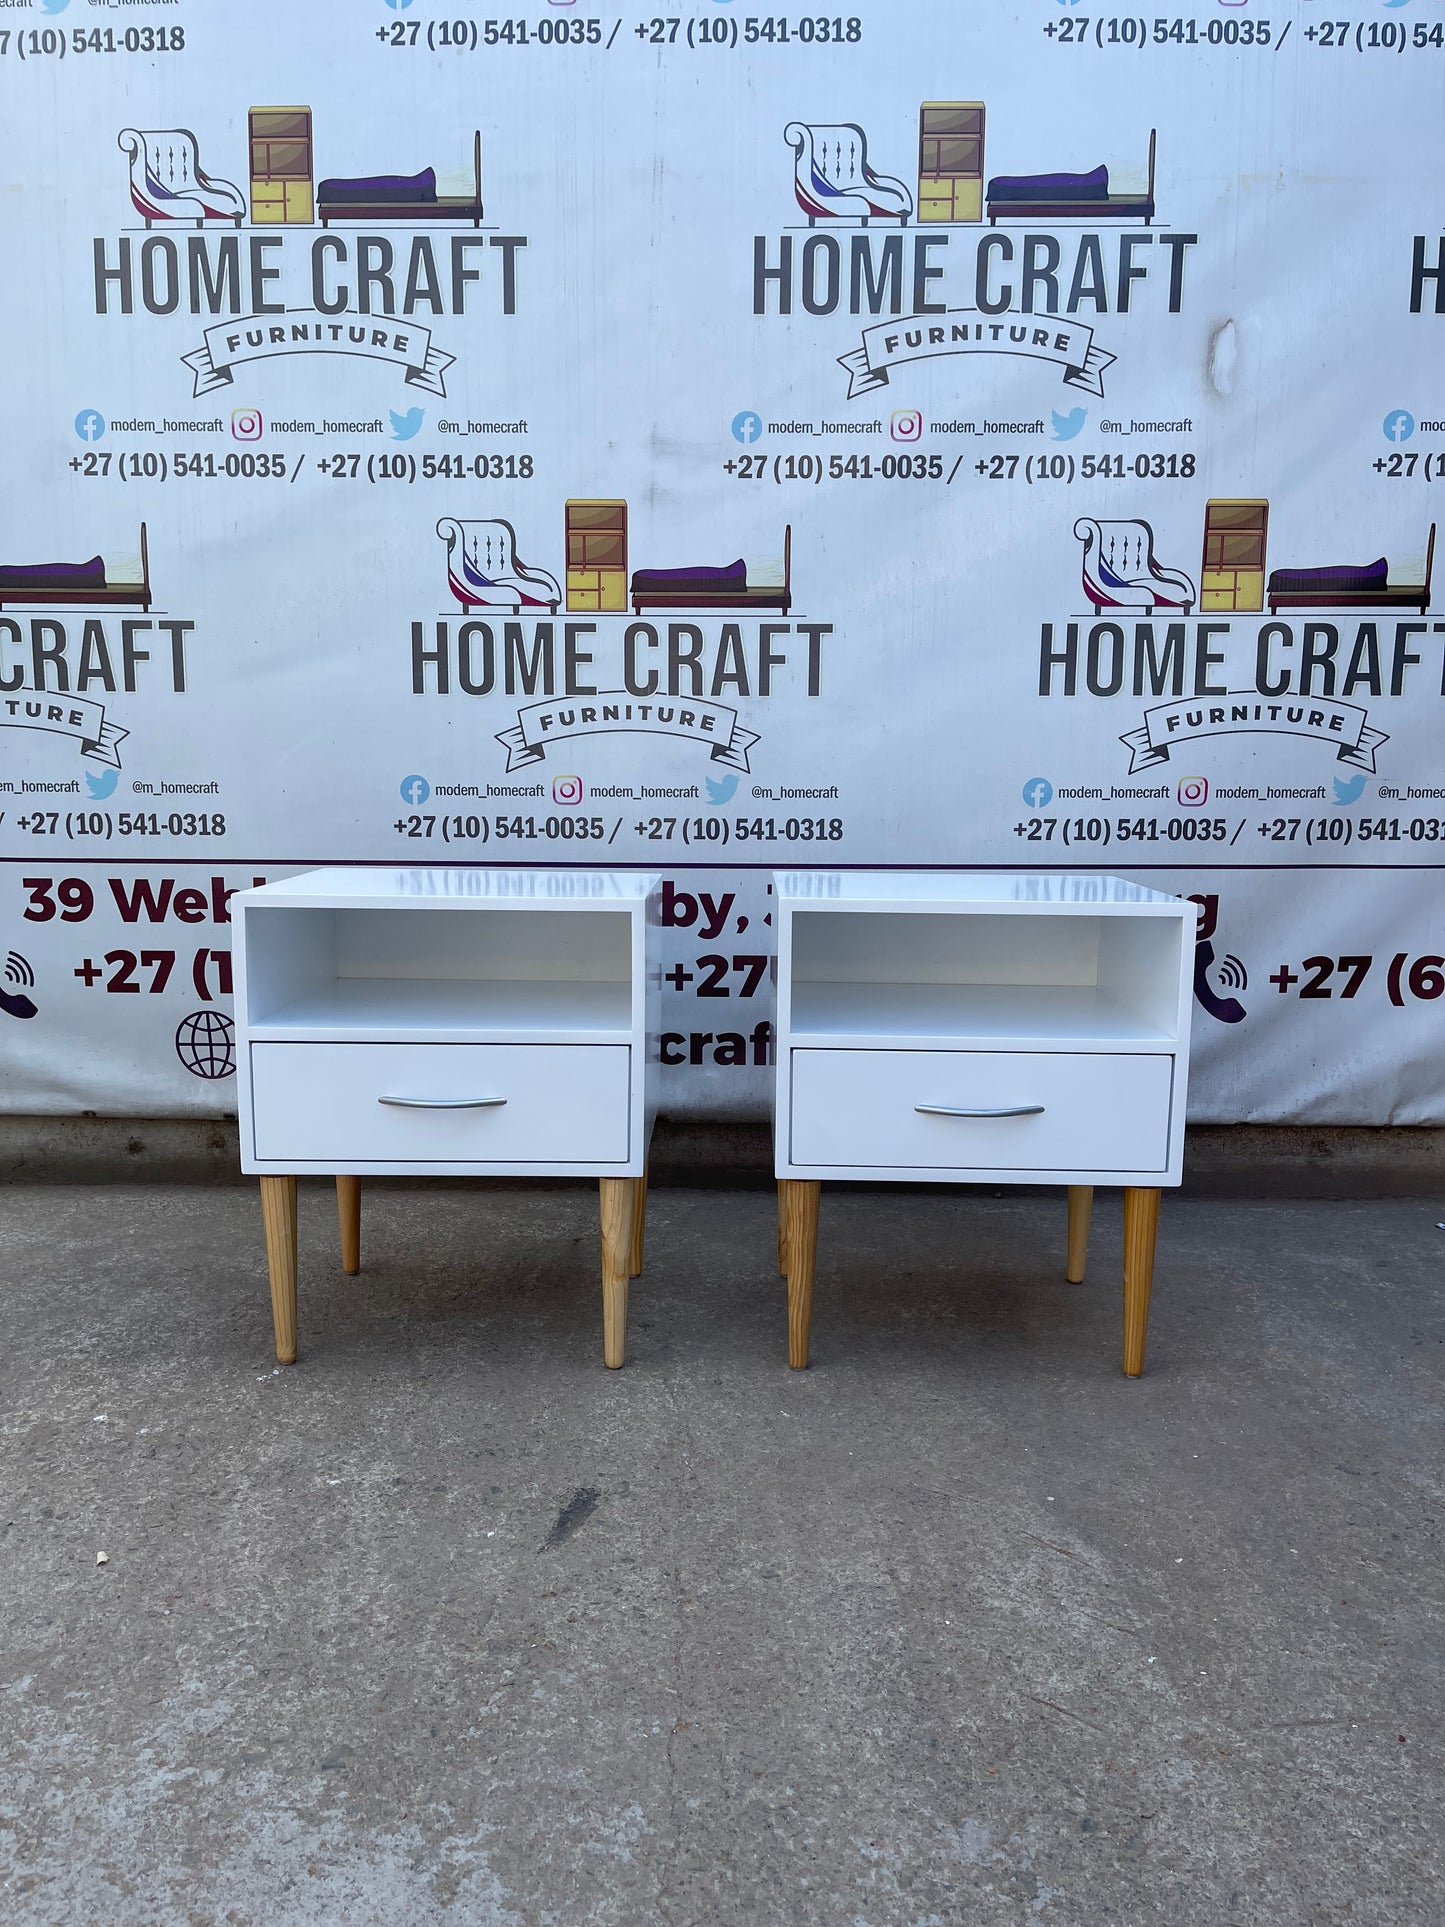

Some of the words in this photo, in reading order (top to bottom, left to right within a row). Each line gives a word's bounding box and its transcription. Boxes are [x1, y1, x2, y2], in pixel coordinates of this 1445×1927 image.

[18, 29, 66, 60] (10)
[73, 26, 185, 53] 541-0318
[376, 21, 420, 46] +27
[428, 20, 477, 51] (10)
[484, 19, 601, 45] 541-0035
[635, 18, 680, 43] +27
[687, 18, 737, 48] (10)
[744, 17, 861, 42] 541-0318
[1043, 18, 1089, 42] +27
[1096, 18, 1146, 48] (10)
[1153, 19, 1270, 45] 541-0035
[1304, 21, 1350, 46] +27
[1356, 22, 1406, 53] (10)
[94, 236, 285, 315] HOME
[311, 235, 527, 316] CRAFT
[754, 235, 949, 315] HOME
[976, 234, 1197, 316] CRAFT
[226, 323, 409, 353] FURNITURE
[884, 323, 1071, 354] FURNITURE
[438, 420, 528, 435] @m_homecraft
[1100, 418, 1192, 435] @m_homecraft
[69, 453, 112, 476] +27
[119, 453, 167, 482] (10)
[174, 453, 286, 477] 541-0035
[318, 454, 360, 477] +27
[368, 455, 416, 483] (10)
[422, 455, 533, 478] 541-0318
[724, 455, 767, 478] +27
[774, 455, 822, 484] (10)
[829, 455, 942, 479] 541-0035
[975, 455, 1019, 479] +27
[1026, 455, 1074, 484] (10)
[1081, 454, 1195, 478] 541-0318
[1373, 453, 1418, 477] +27
[0, 618, 194, 692] CRAFT
[412, 621, 597, 696] HOME
[623, 622, 833, 697] CRAFT
[1039, 623, 1230, 697] HOME
[539, 705, 715, 732] FURNITURE
[1166, 705, 1345, 732] FURNITURE
[133, 781, 219, 795] @m_homecraft
[752, 786, 838, 800] @m_homecraft
[17, 812, 59, 834] +27
[66, 813, 112, 840] (10)
[119, 813, 225, 836] 541-0318
[394, 816, 436, 837] +27
[443, 816, 489, 843] (10)
[495, 816, 604, 839] 541-0035
[635, 818, 676, 839] +27
[683, 818, 729, 845] (10)
[735, 818, 843, 840] 541-0318
[1014, 819, 1057, 840] +27
[1063, 819, 1110, 846] (10)
[1117, 819, 1226, 840] 541-0035
[1258, 819, 1301, 840] +27
[1306, 819, 1352, 845] (10)
[23, 877, 94, 923] 39
[108, 877, 267, 924] Web
[74, 950, 176, 994] +27
[666, 955, 768, 998] +27
[1269, 955, 1373, 998] +27
